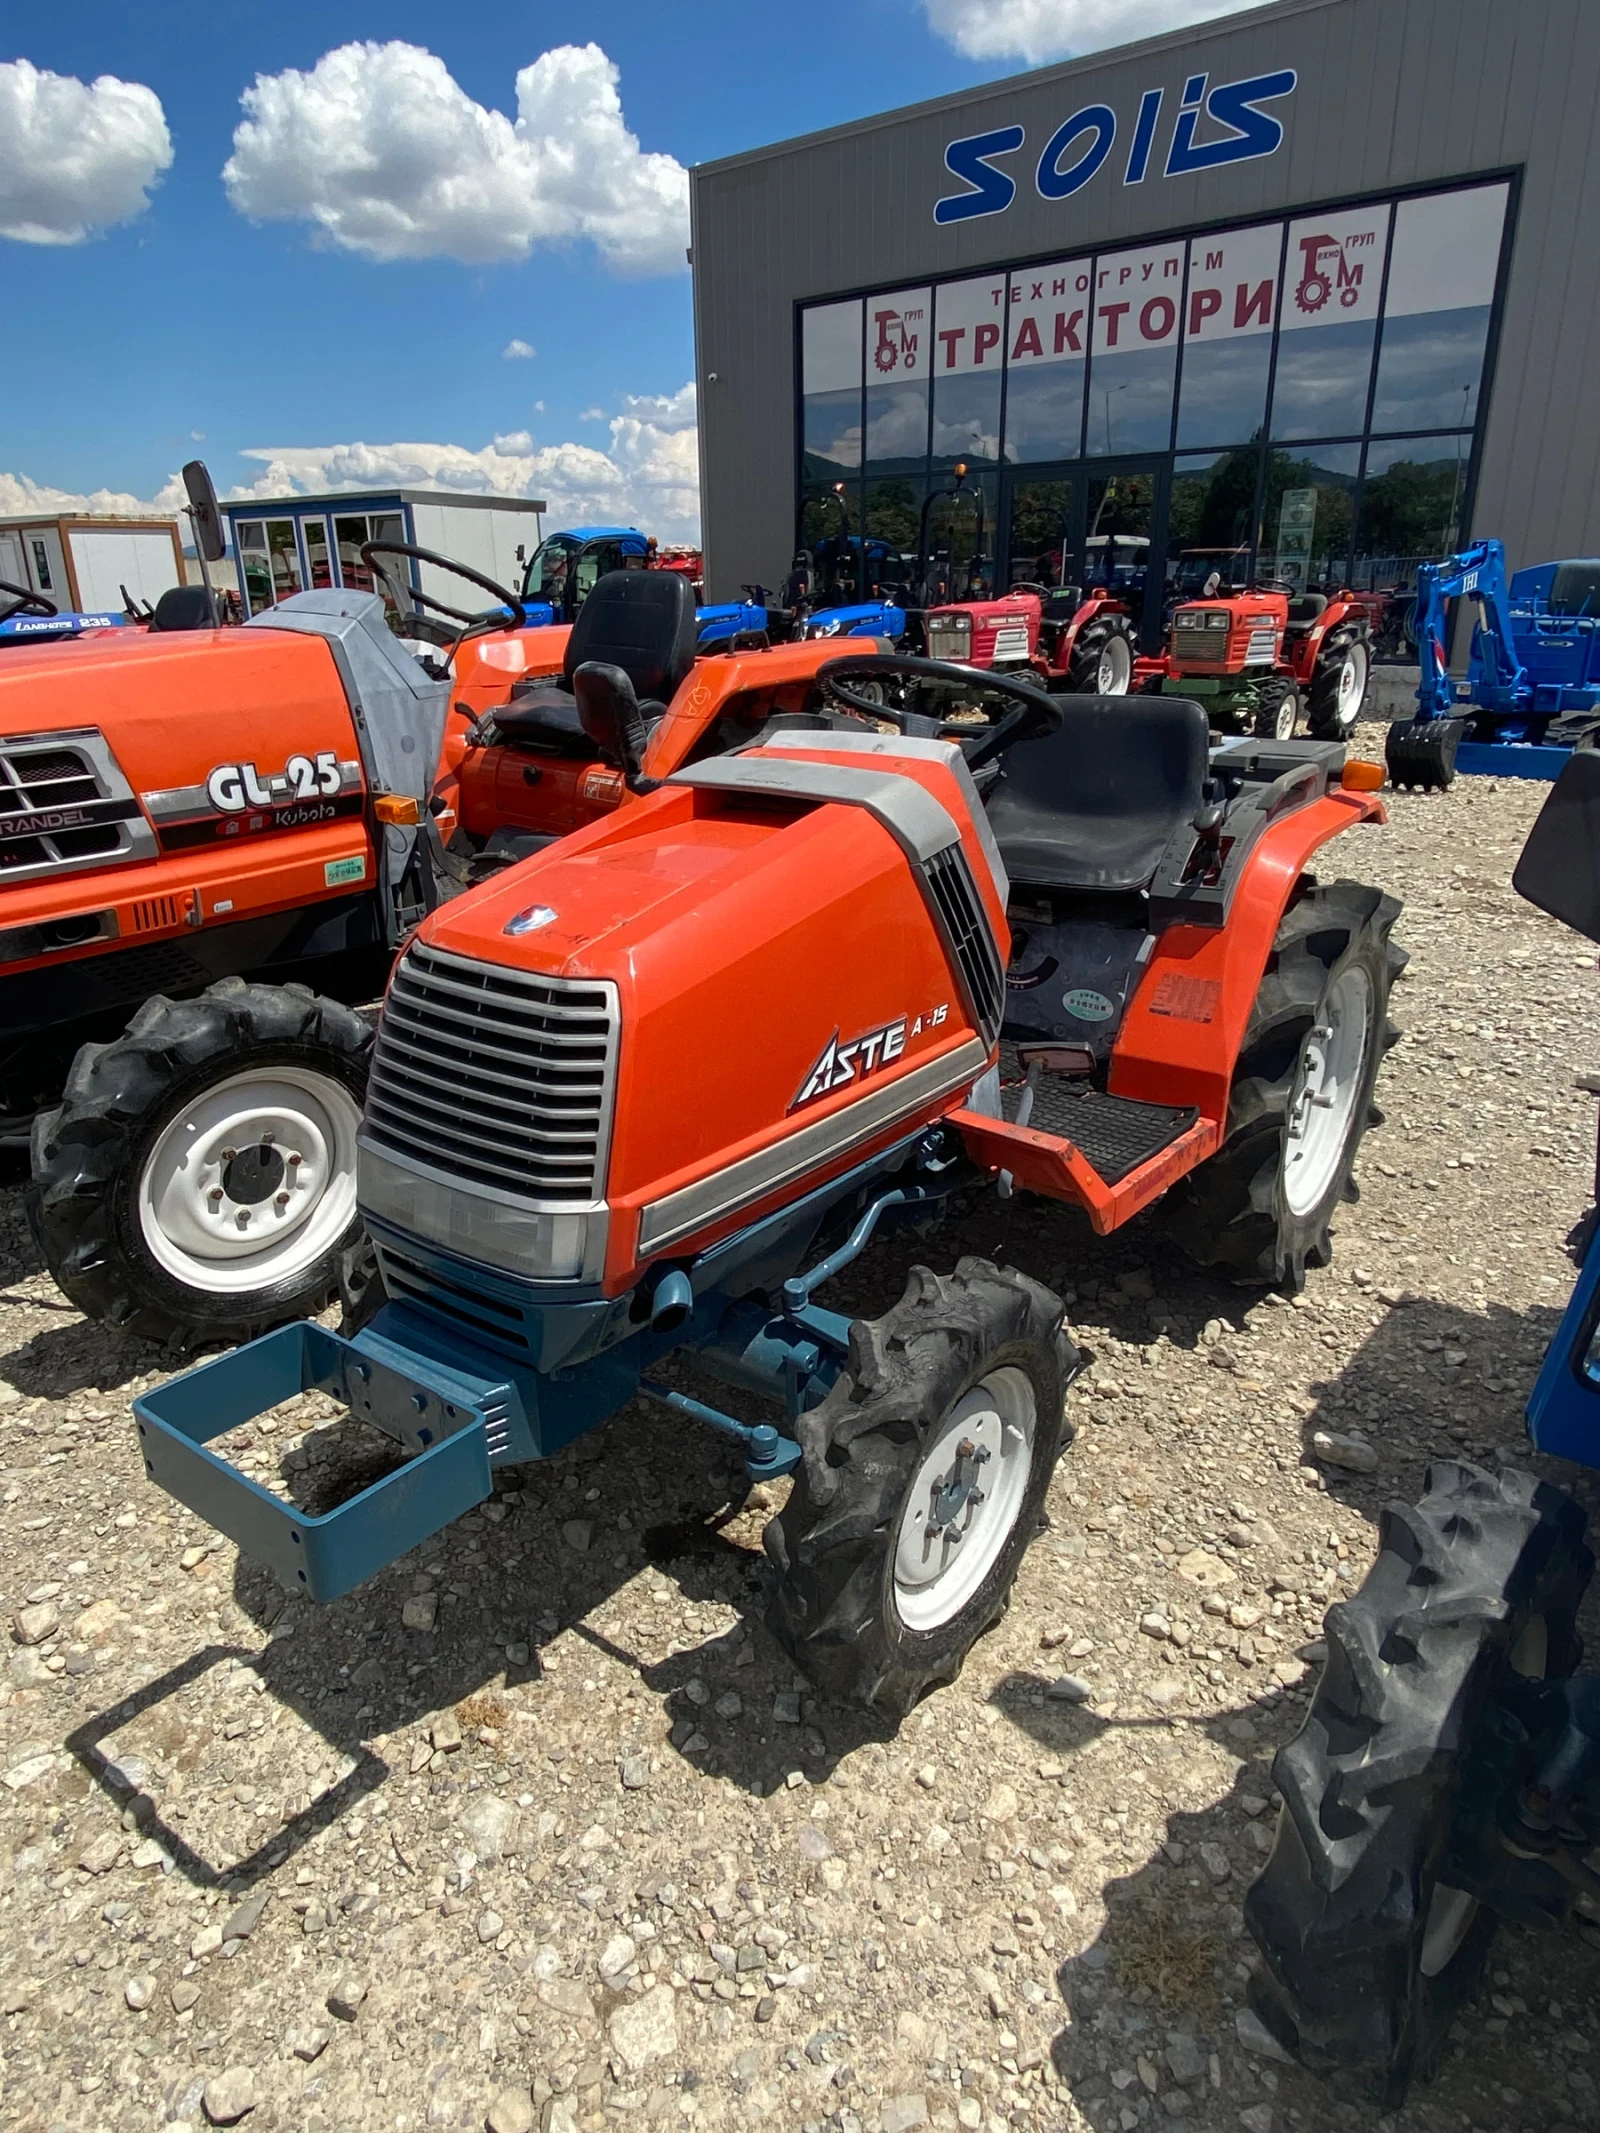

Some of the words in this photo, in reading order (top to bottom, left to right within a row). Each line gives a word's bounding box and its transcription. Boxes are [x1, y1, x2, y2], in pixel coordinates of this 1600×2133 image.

[1345, 231, 1375, 249] ГРУП
[938, 279, 1275, 369] ТРАКТОРИ
[1462, 571, 1478, 594] IHI
[78, 617, 111, 628] 235
[208, 752, 341, 811] GL-25
[275, 804, 335, 826] Kubota
[797, 1022, 906, 1103] ASTE
